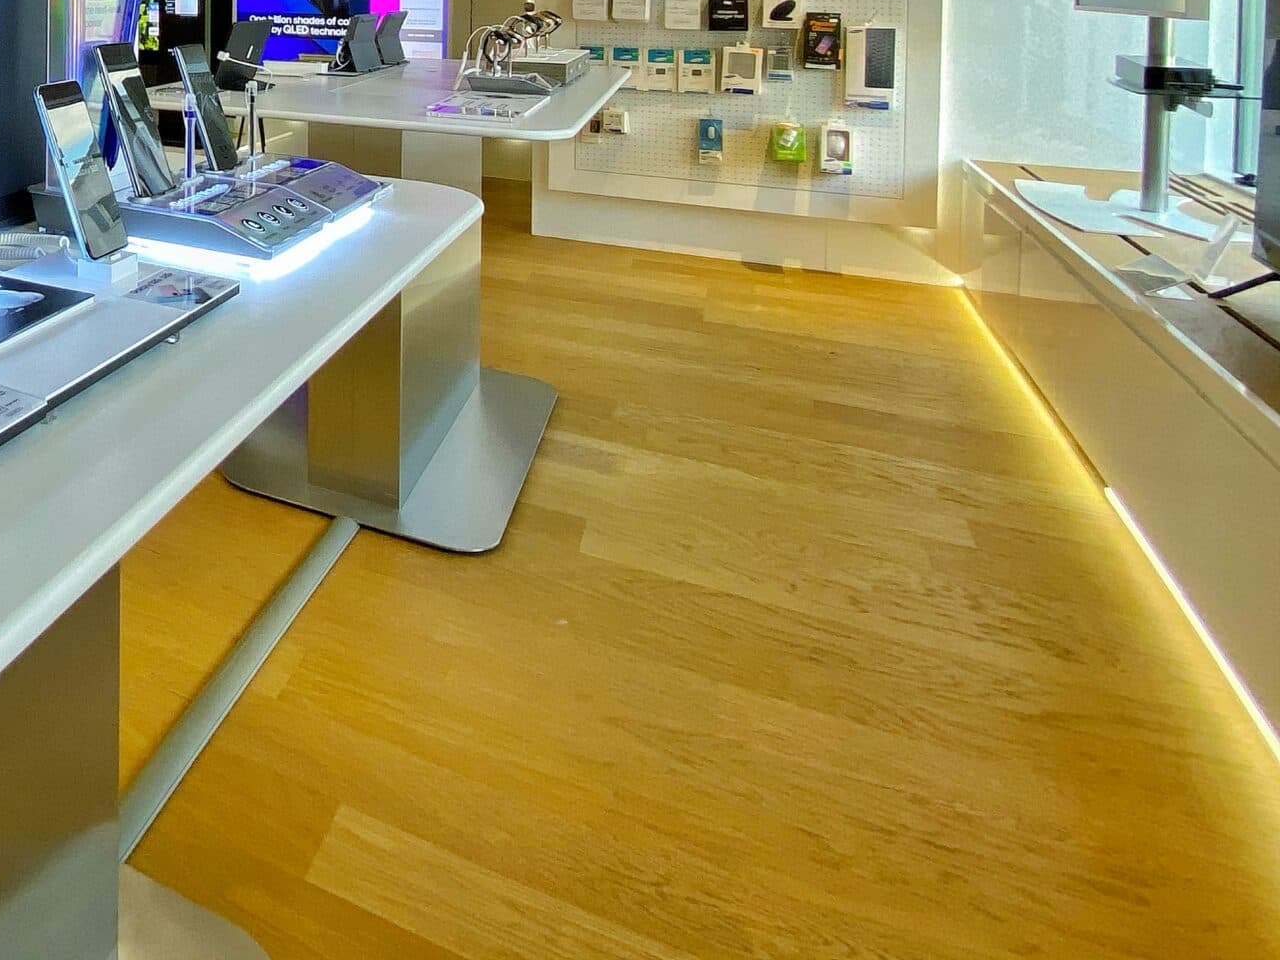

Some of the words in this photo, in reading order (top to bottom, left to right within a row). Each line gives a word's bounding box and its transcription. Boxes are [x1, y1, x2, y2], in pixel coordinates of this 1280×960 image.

[292, 16, 325, 25] shades
[326, 16, 336, 26] of
[283, 25, 310, 34] QLED
